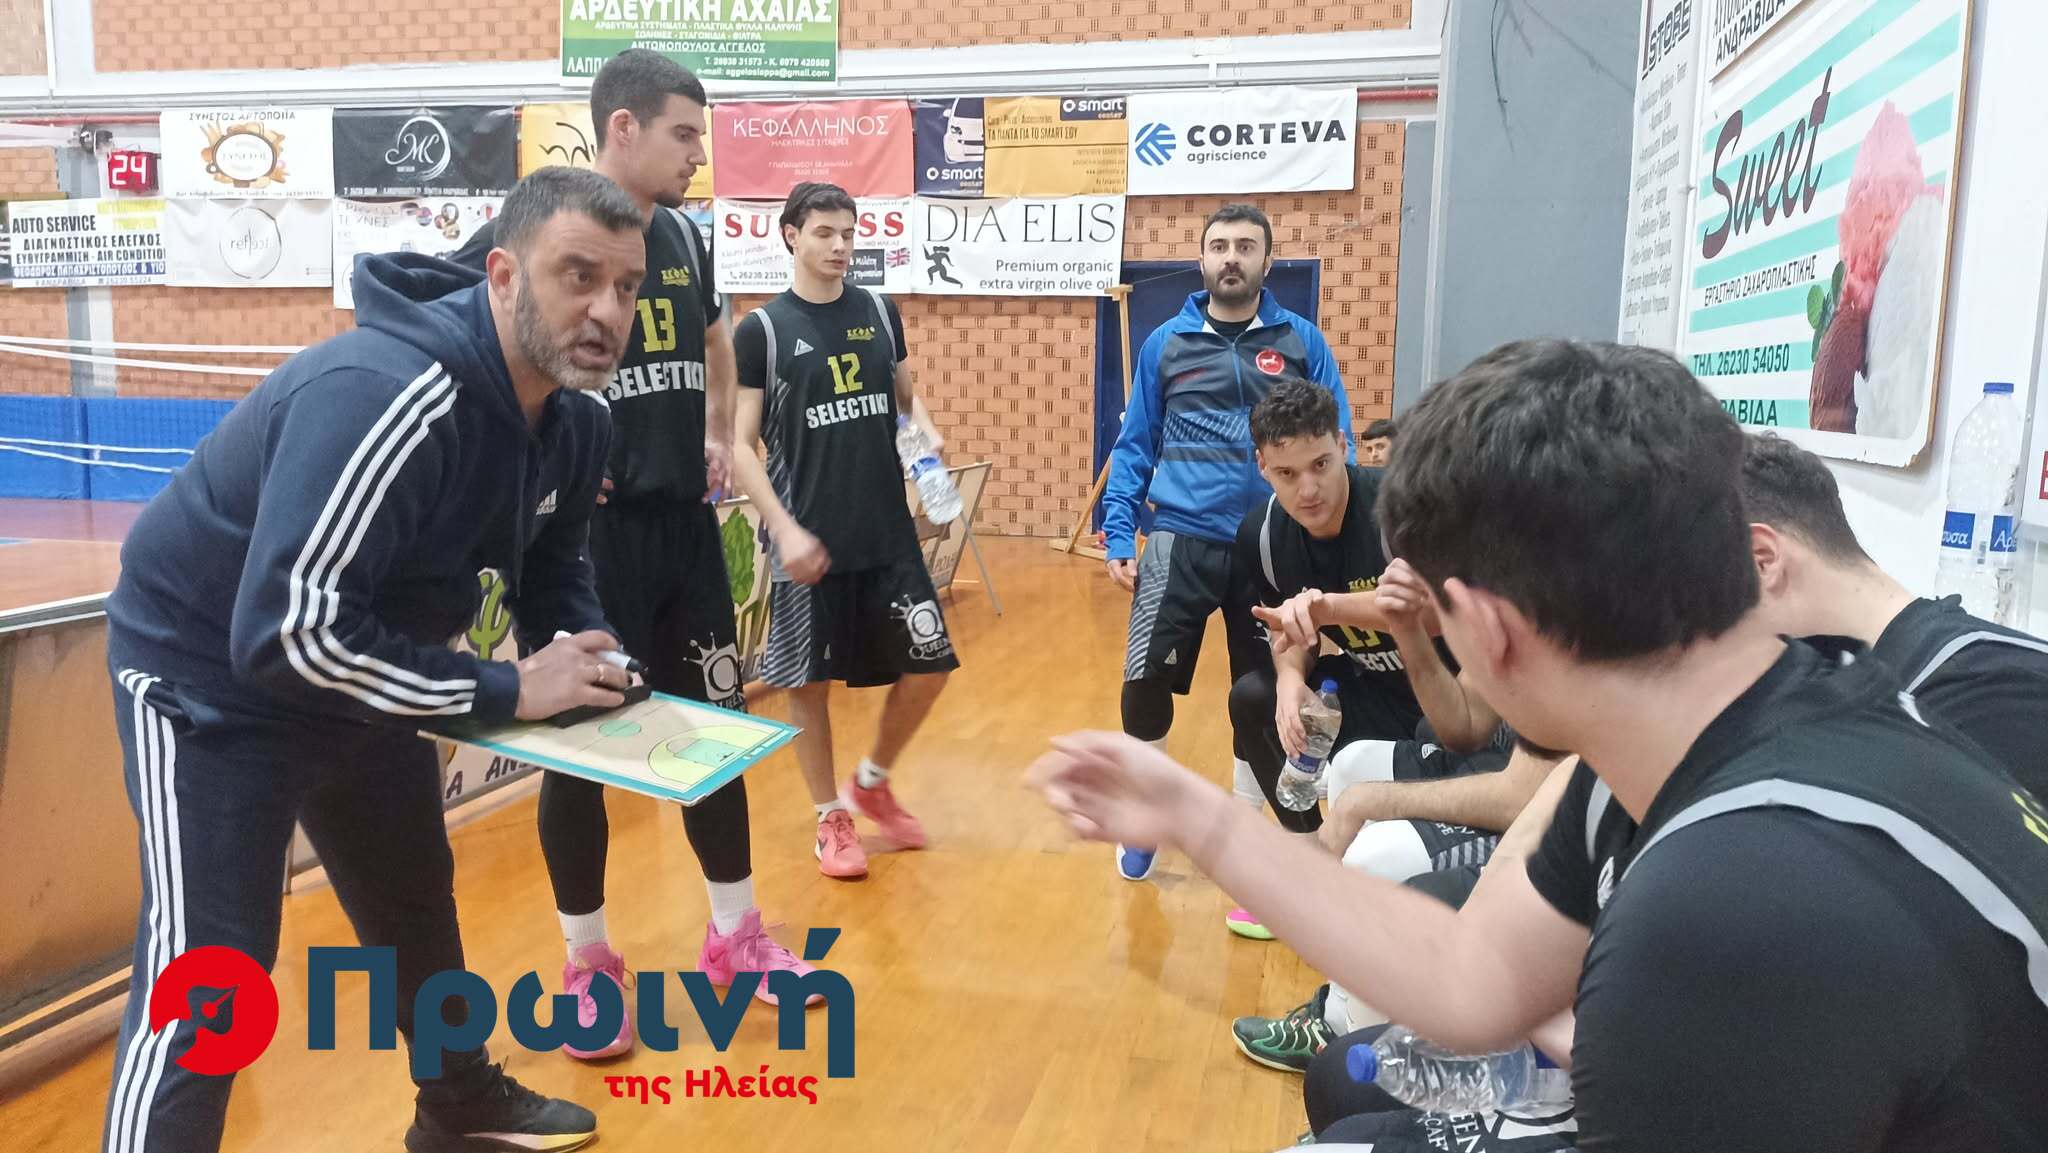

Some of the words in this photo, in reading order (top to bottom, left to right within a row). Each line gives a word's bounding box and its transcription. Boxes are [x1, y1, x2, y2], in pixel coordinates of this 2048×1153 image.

[1078, 99, 1123, 112] smart
[733, 115, 889, 137] ΚΕΦΑΛΛΗΝΟΣ
[1186, 120, 1347, 148] CORTEVA
[1186, 149, 1267, 164] agriscience
[1702, 66, 1833, 260] Sweet
[111, 155, 147, 185] 24
[941, 166, 984, 180] smart
[12, 217, 44, 234] AUTO
[47, 214, 97, 232] SERVICE
[927, 203, 1008, 243] DIA
[1023, 202, 1117, 243] ELIS
[111, 233, 161, 248] ΕΛΕΓΧΟΣ
[116, 248, 166, 261] CONDITIO
[996, 258, 1060, 274] Premium
[1063, 258, 1114, 277] organic
[979, 278, 1015, 290] extra
[1017, 277, 1057, 293] virgin
[1060, 277, 1094, 290] olive
[1097, 276, 1113, 290] oil
[636, 298, 677, 353] 13
[1693, 353, 1715, 376] ΤΗΛ.
[1717, 348, 1749, 376] 26230
[1752, 343, 1790, 374] 54050
[827, 352, 864, 395] 12
